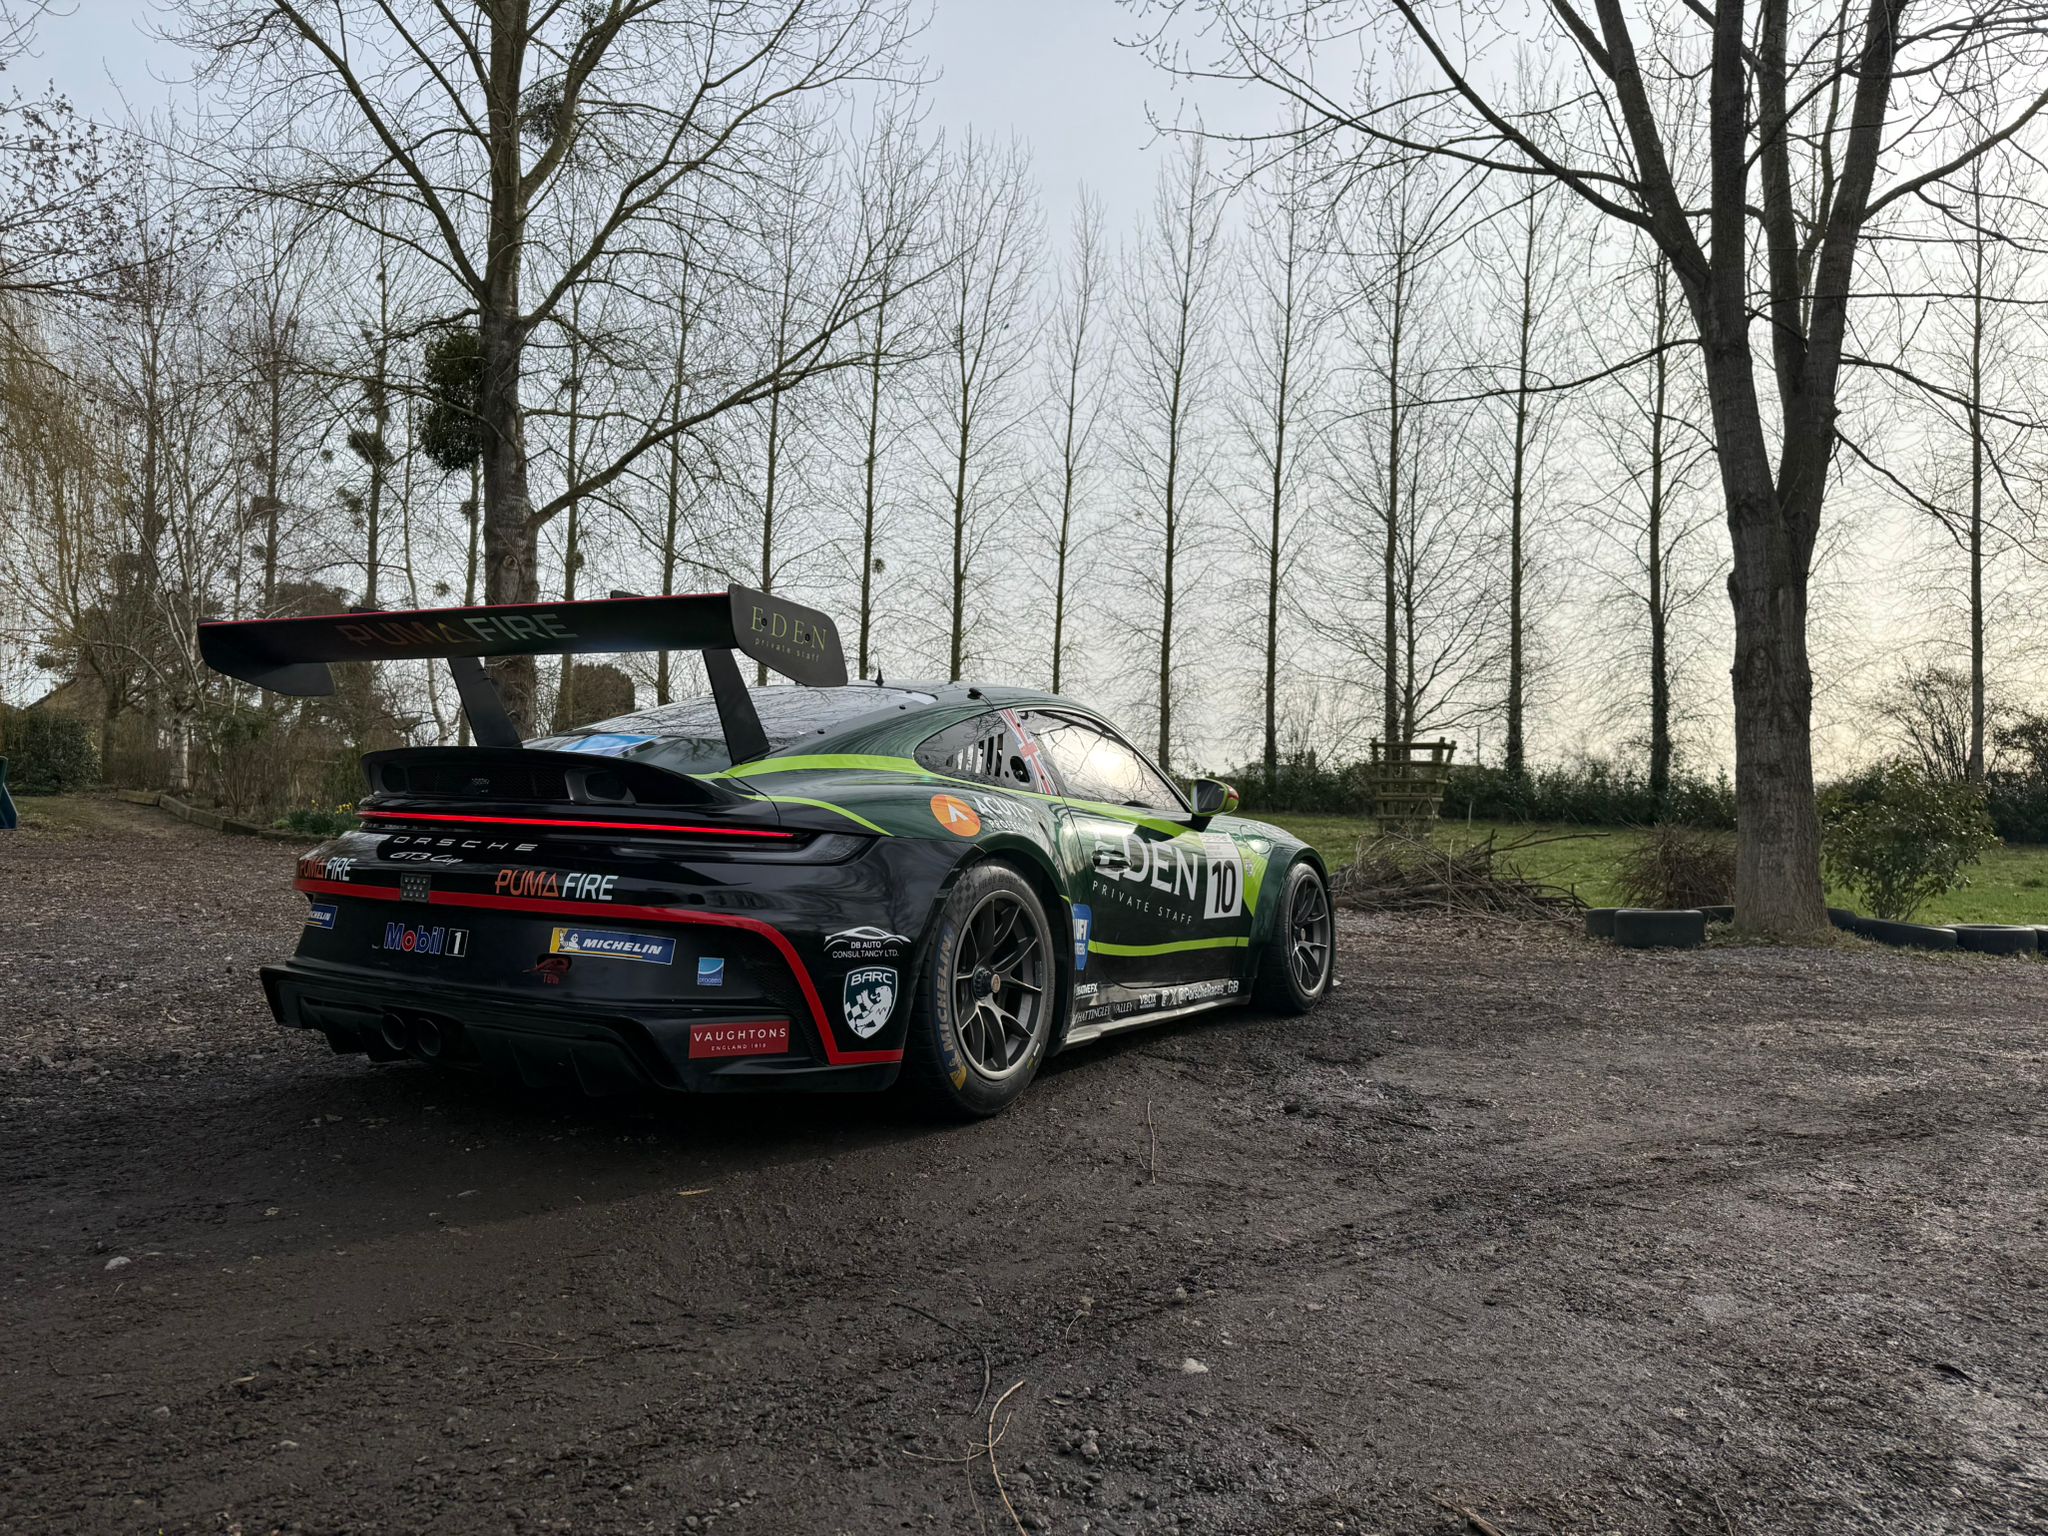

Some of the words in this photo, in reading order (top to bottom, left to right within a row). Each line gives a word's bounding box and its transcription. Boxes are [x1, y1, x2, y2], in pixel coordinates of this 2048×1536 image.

[751, 606, 827, 652] EDEN
[754, 638, 792, 654] private
[796, 650, 820, 663] staff
[389, 851, 429, 861] GT3
[429, 853, 464, 866] Cup
[1211, 859, 1237, 914] 10
[1092, 880, 1150, 913] PRIVATE
[1158, 906, 1193, 926] STAFF
[383, 922, 445, 955] Mobil
[583, 938, 663, 955] MICHELIN
[851, 941, 861, 949] DB
[862, 940, 882, 949] AUTO
[832, 949, 883, 959] CONSULTANCY
[884, 948, 900, 957] LTD.
[850, 971, 893, 986] BARC
[936, 934, 955, 1053] MICHELIN
[693, 1028, 786, 1043] VAUGHTONS
[711, 1043, 748, 1051] ENGLAND
